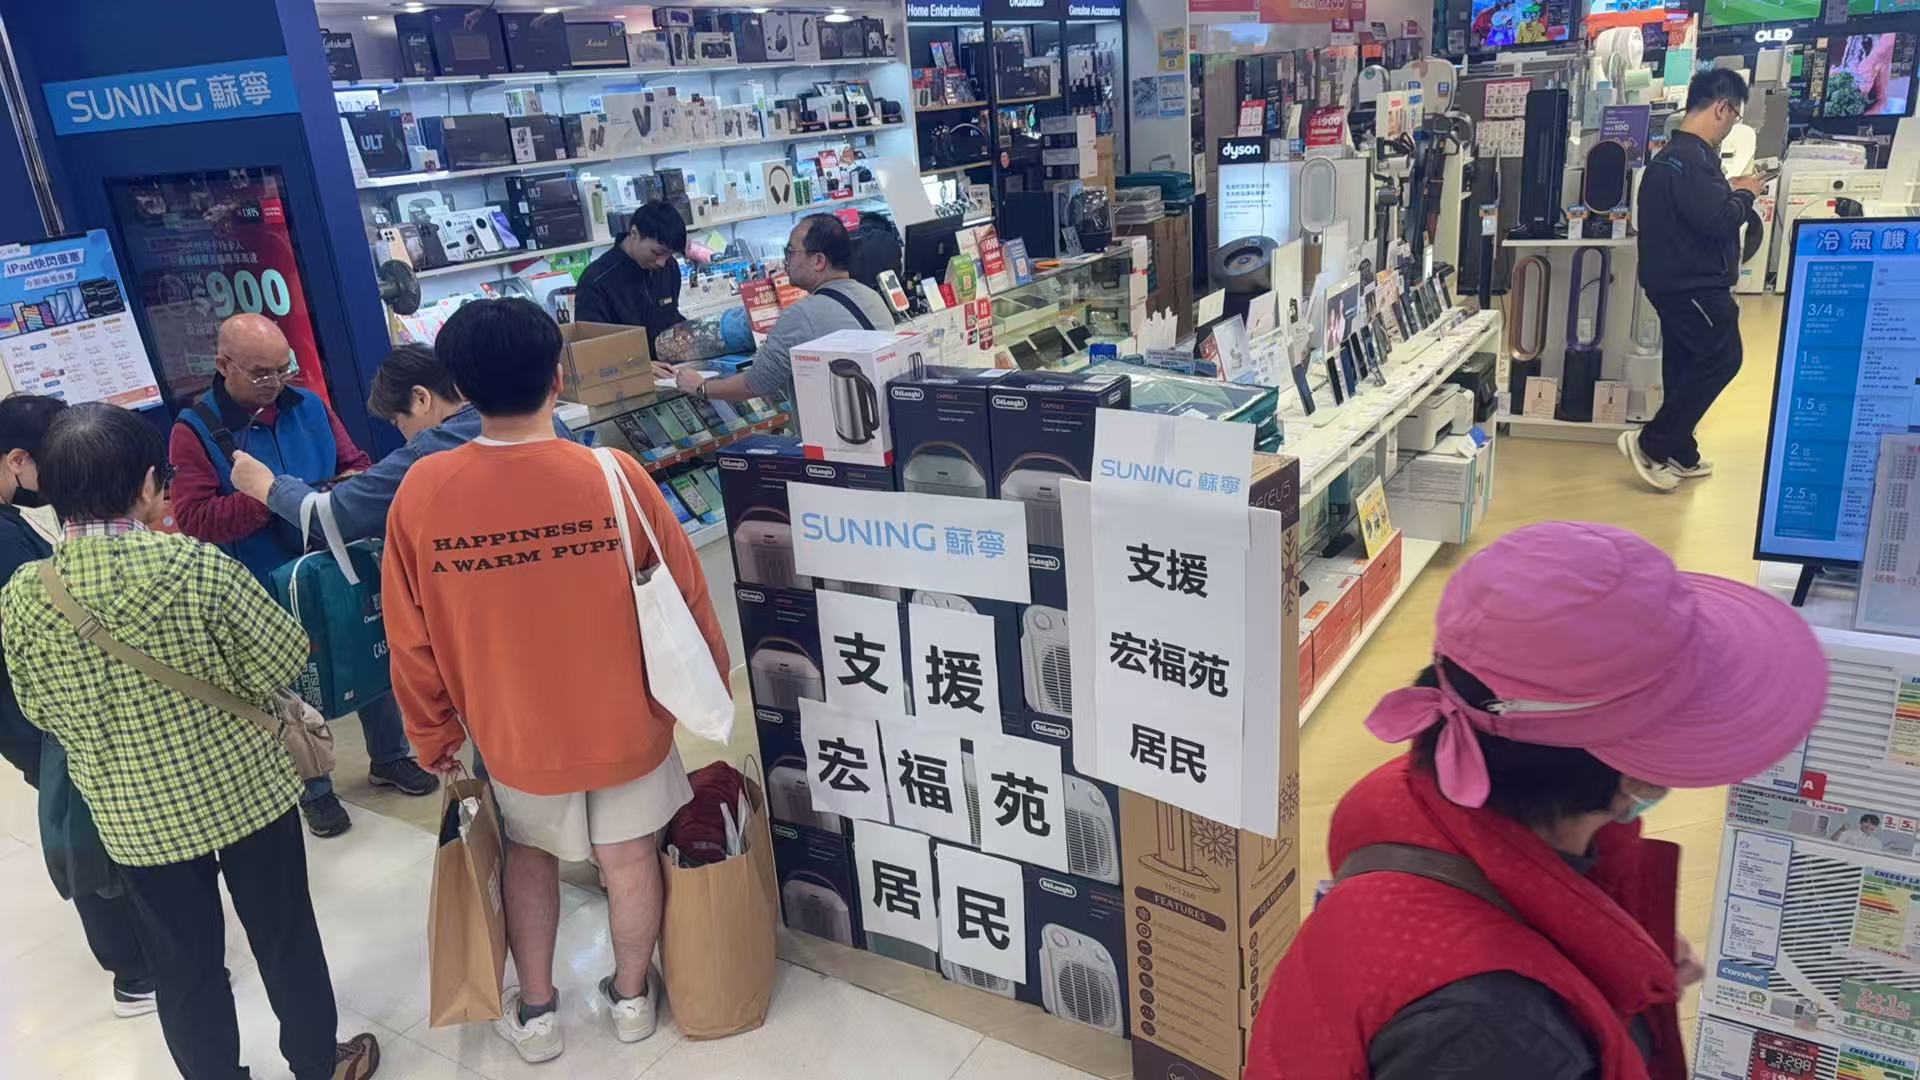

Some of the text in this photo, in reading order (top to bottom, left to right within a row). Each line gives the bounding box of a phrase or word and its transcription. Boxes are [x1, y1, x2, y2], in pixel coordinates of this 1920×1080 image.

[907, 4, 981, 17] Home Entertainment
[1068, 4, 1120, 16] Genuine Accessories
[1755, 28, 1793, 43] OLED
[66, 70, 272, 123] SUNING 蘇寧
[360, 133, 384, 151] ULT
[1222, 142, 1261, 160] dyson
[1817, 229, 1920, 251] 冷氣機
[1808, 303, 1833, 317] 3/4
[794, 354, 821, 363] TOSHIBA
[1796, 397, 1815, 410] 1.5
[1790, 443, 1799, 456] 2
[1100, 459, 1241, 495] SUNING 蘇寧
[1785, 486, 1807, 500] 2.5
[432, 519, 593, 552] HAPPINESS
[800, 512, 1007, 559] SUNING 蘇寧
[431, 538, 623, 573] A WARM PUPP
[1125, 542, 1209, 598] 支援
[373, 640, 388, 659] CAS
[1108, 630, 1230, 699] 宏福苑
[1129, 722, 1208, 785] 居民
[1874, 870, 1907, 882] ENERGY
[1154, 892, 1207, 923] FEATURES
[1258, 879, 1288, 917] FEATURES
[1849, 1047, 1907, 1067] ENERGY LABEL
